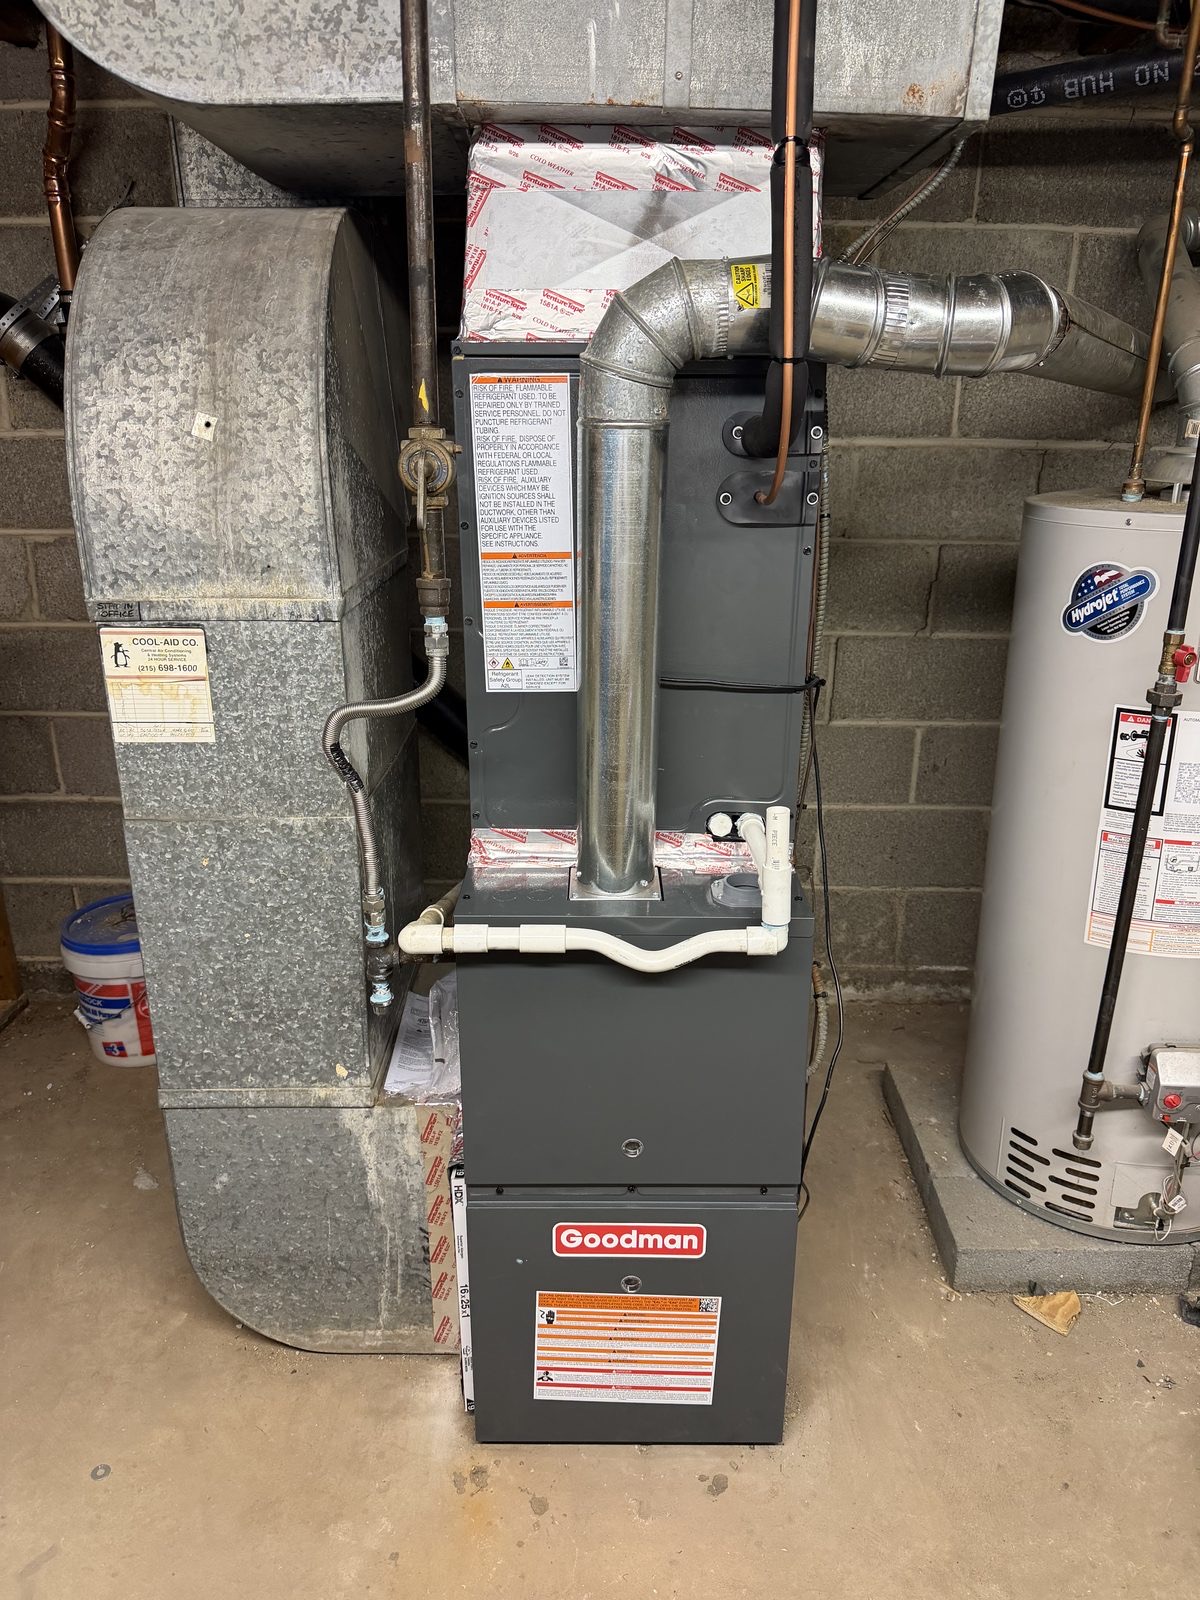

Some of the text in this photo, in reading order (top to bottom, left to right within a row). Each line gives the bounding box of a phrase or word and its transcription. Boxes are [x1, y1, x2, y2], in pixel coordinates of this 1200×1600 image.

[1064, 61, 1169, 99] NO HUB
[737, 127, 775, 151] VentureTap
[530, 153, 547, 166] COLD
[547, 161, 575, 177] WEATHER
[485, 290, 527, 312] VentureTape
[543, 292, 585, 314] VentureTape
[532, 316, 548, 328] COLD
[1120, 579, 1145, 594] PERFORMANCE
[100, 610, 134, 618] OFFICE
[1071, 588, 1119, 623] Hydrojet
[132, 638, 180, 646] COOL-AID
[454, 1185, 462, 1205] HDX
[560, 1228, 698, 1250] Goodman
